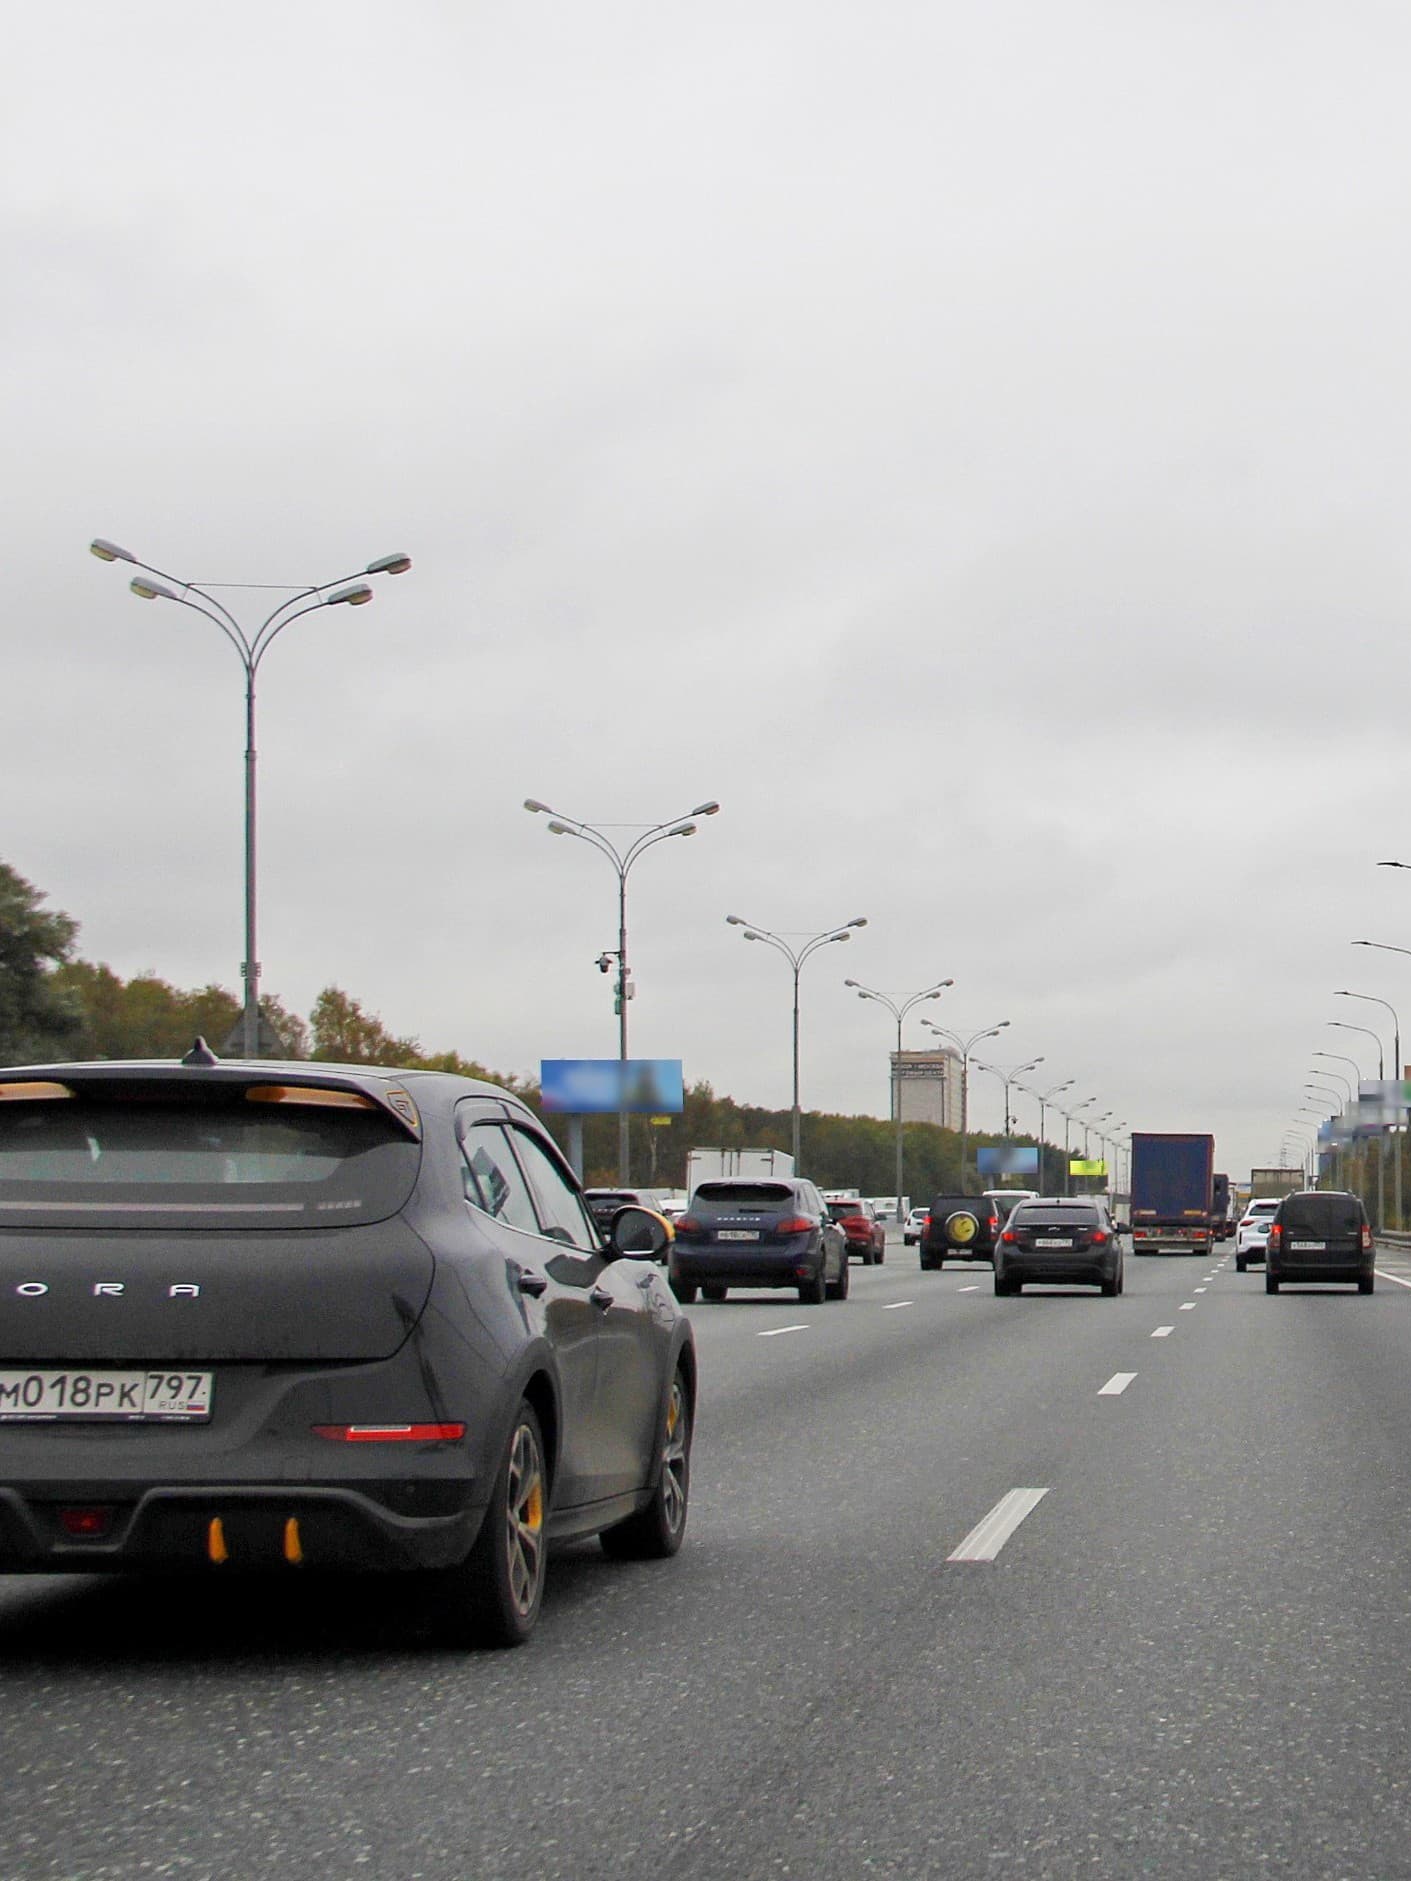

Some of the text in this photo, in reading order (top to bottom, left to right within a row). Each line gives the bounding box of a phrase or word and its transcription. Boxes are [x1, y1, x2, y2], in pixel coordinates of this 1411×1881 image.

[16, 1282, 200, 1298] ORA
[149, 1374, 203, 1400] 797
[158, 1401, 186, 1411] RUS
